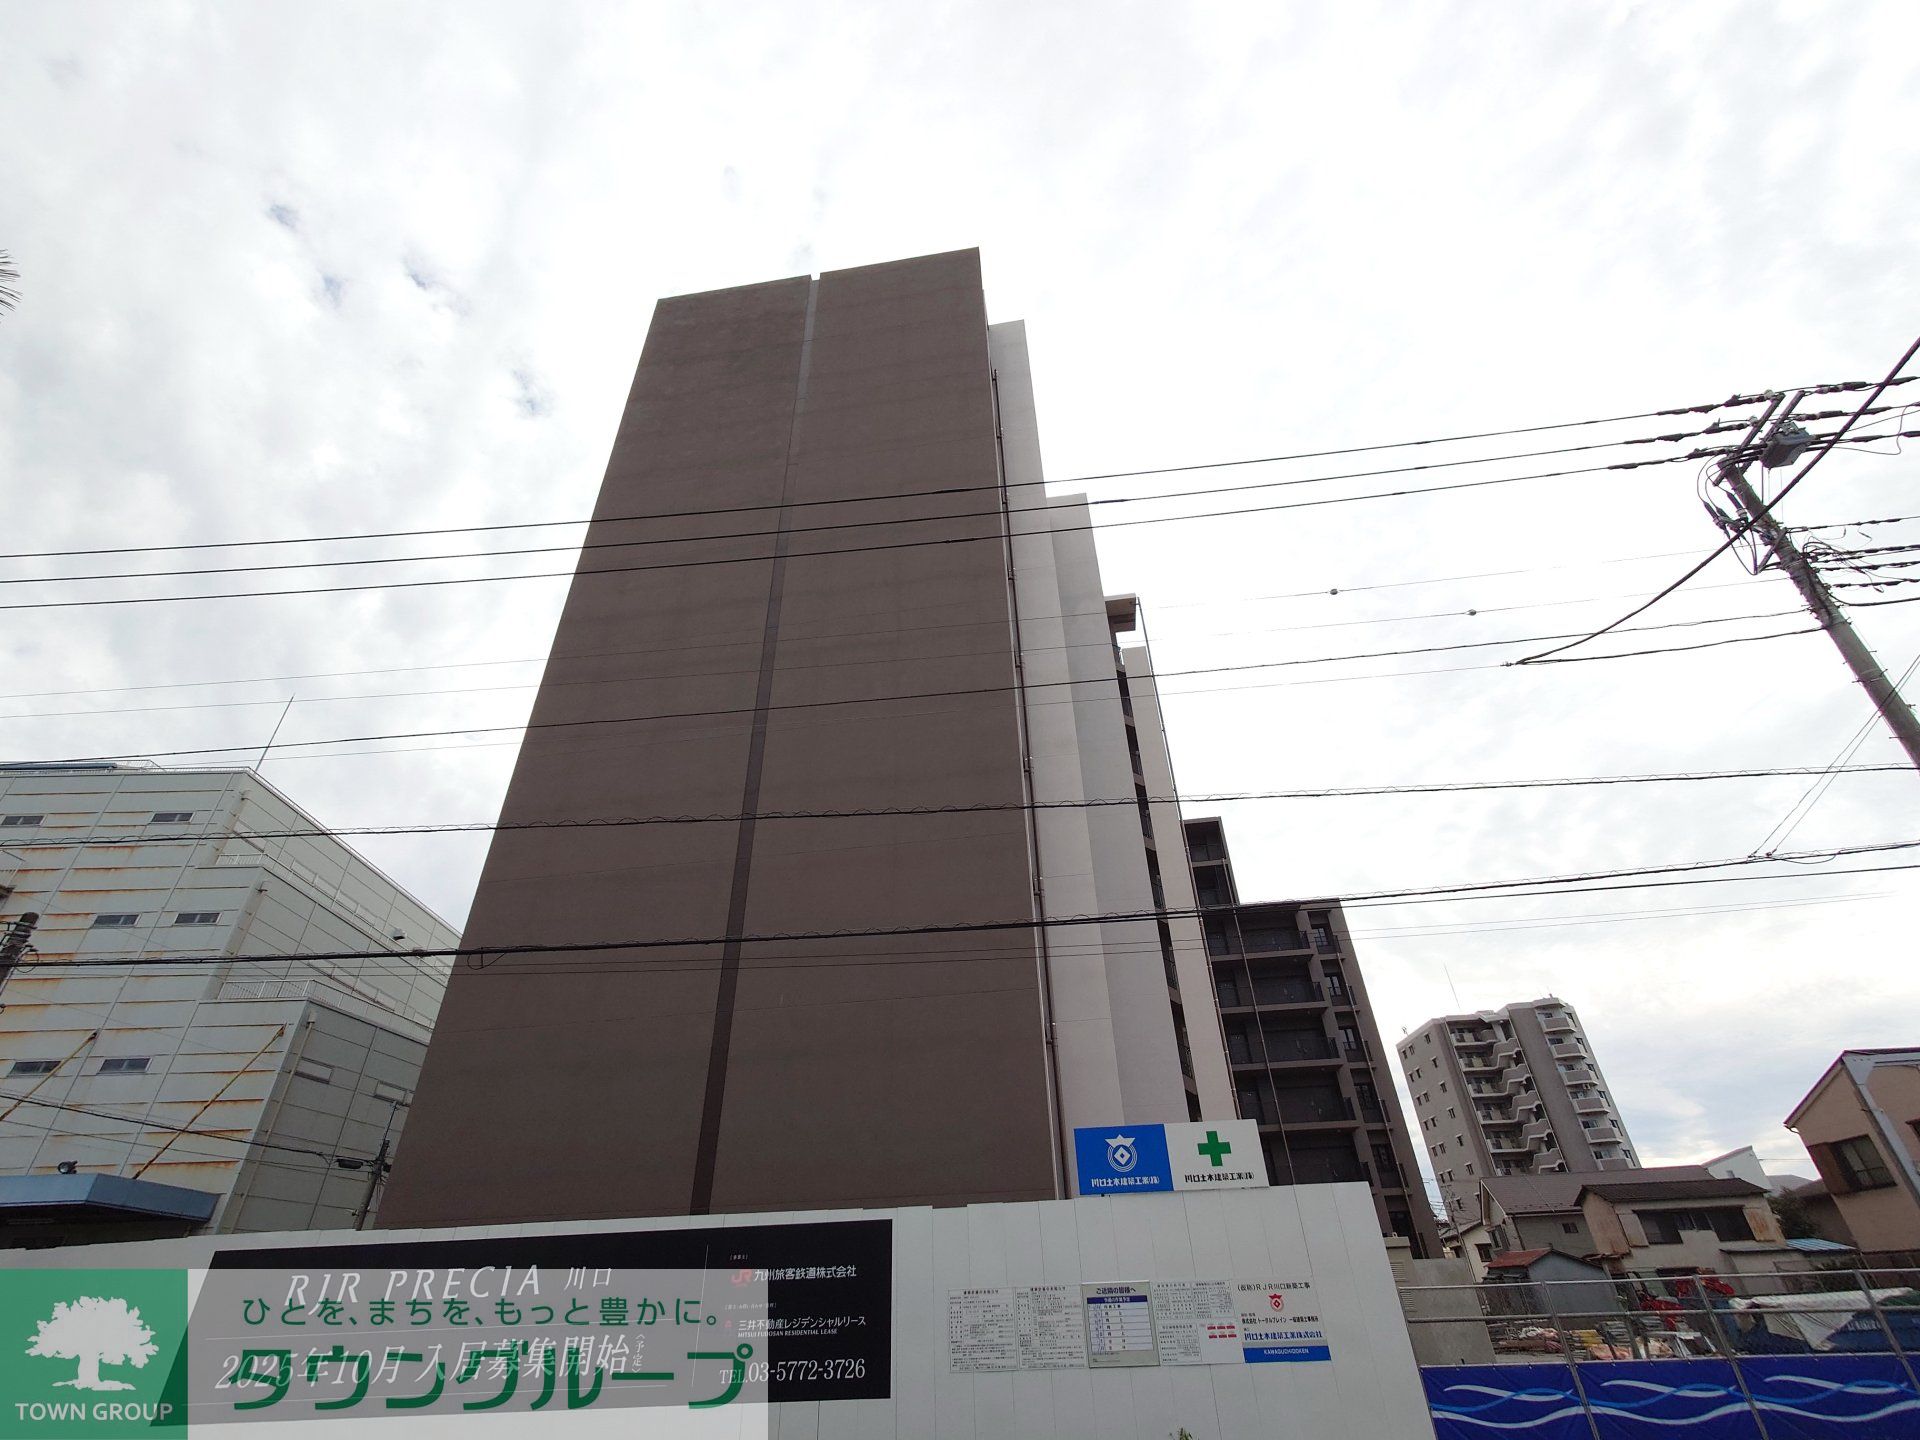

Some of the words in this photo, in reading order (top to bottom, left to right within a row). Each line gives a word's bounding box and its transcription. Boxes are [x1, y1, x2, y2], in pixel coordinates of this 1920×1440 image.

[753, 1264, 857, 1282] 九州旅客鉄道株式会社
[284, 1272, 361, 1316] RJR
[385, 1264, 540, 1302] PRECIA
[564, 1265, 613, 1291] 川口
[738, 1315, 866, 1332] 三井不動産レジデンシャルリース
[757, 1330, 784, 1338] FUDOSAN
[784, 1329, 820, 1337] RESIDENTIAL
